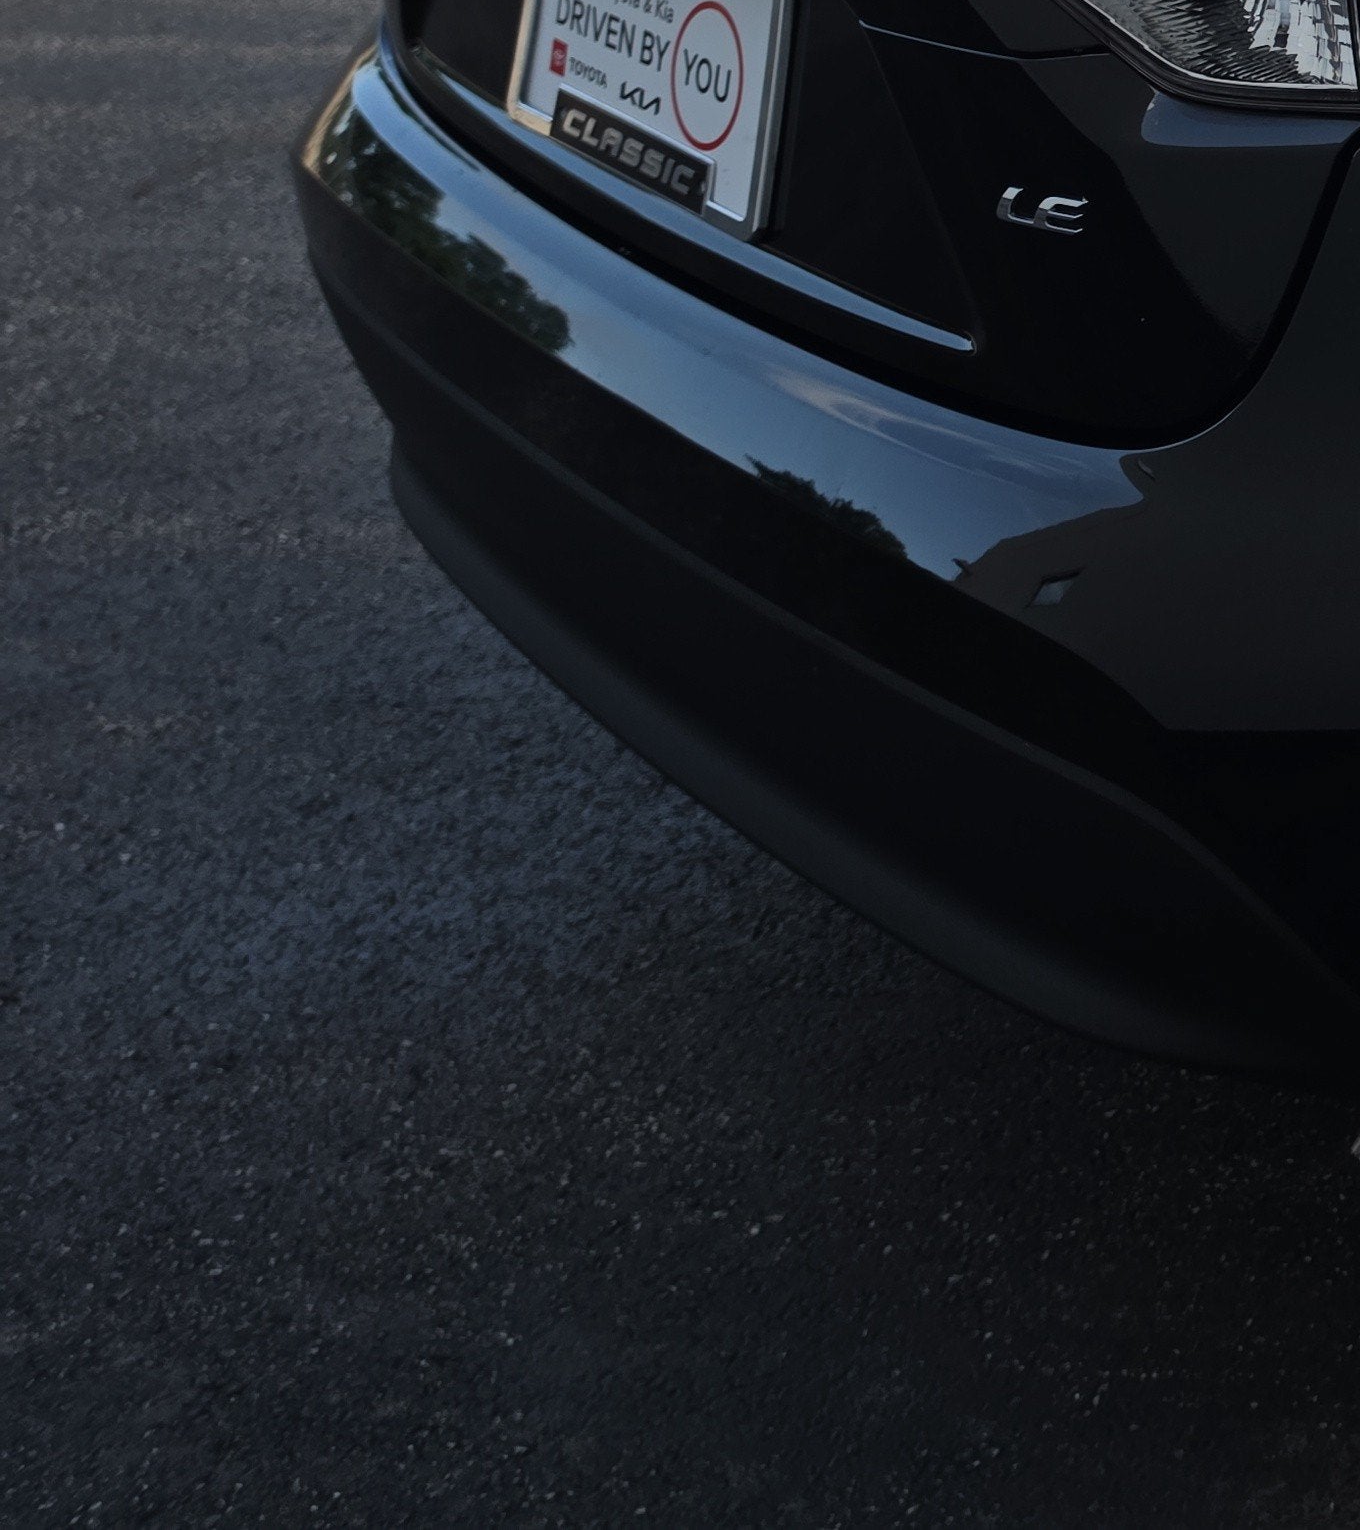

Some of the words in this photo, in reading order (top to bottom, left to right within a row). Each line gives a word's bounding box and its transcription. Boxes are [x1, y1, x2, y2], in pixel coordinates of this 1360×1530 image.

[569, 56, 608, 88] TOYOTA
[639, 29, 671, 72] BY
[682, 48, 732, 103] YOU
[562, 108, 696, 195] CLASSIC
[996, 186, 1088, 235] LE
